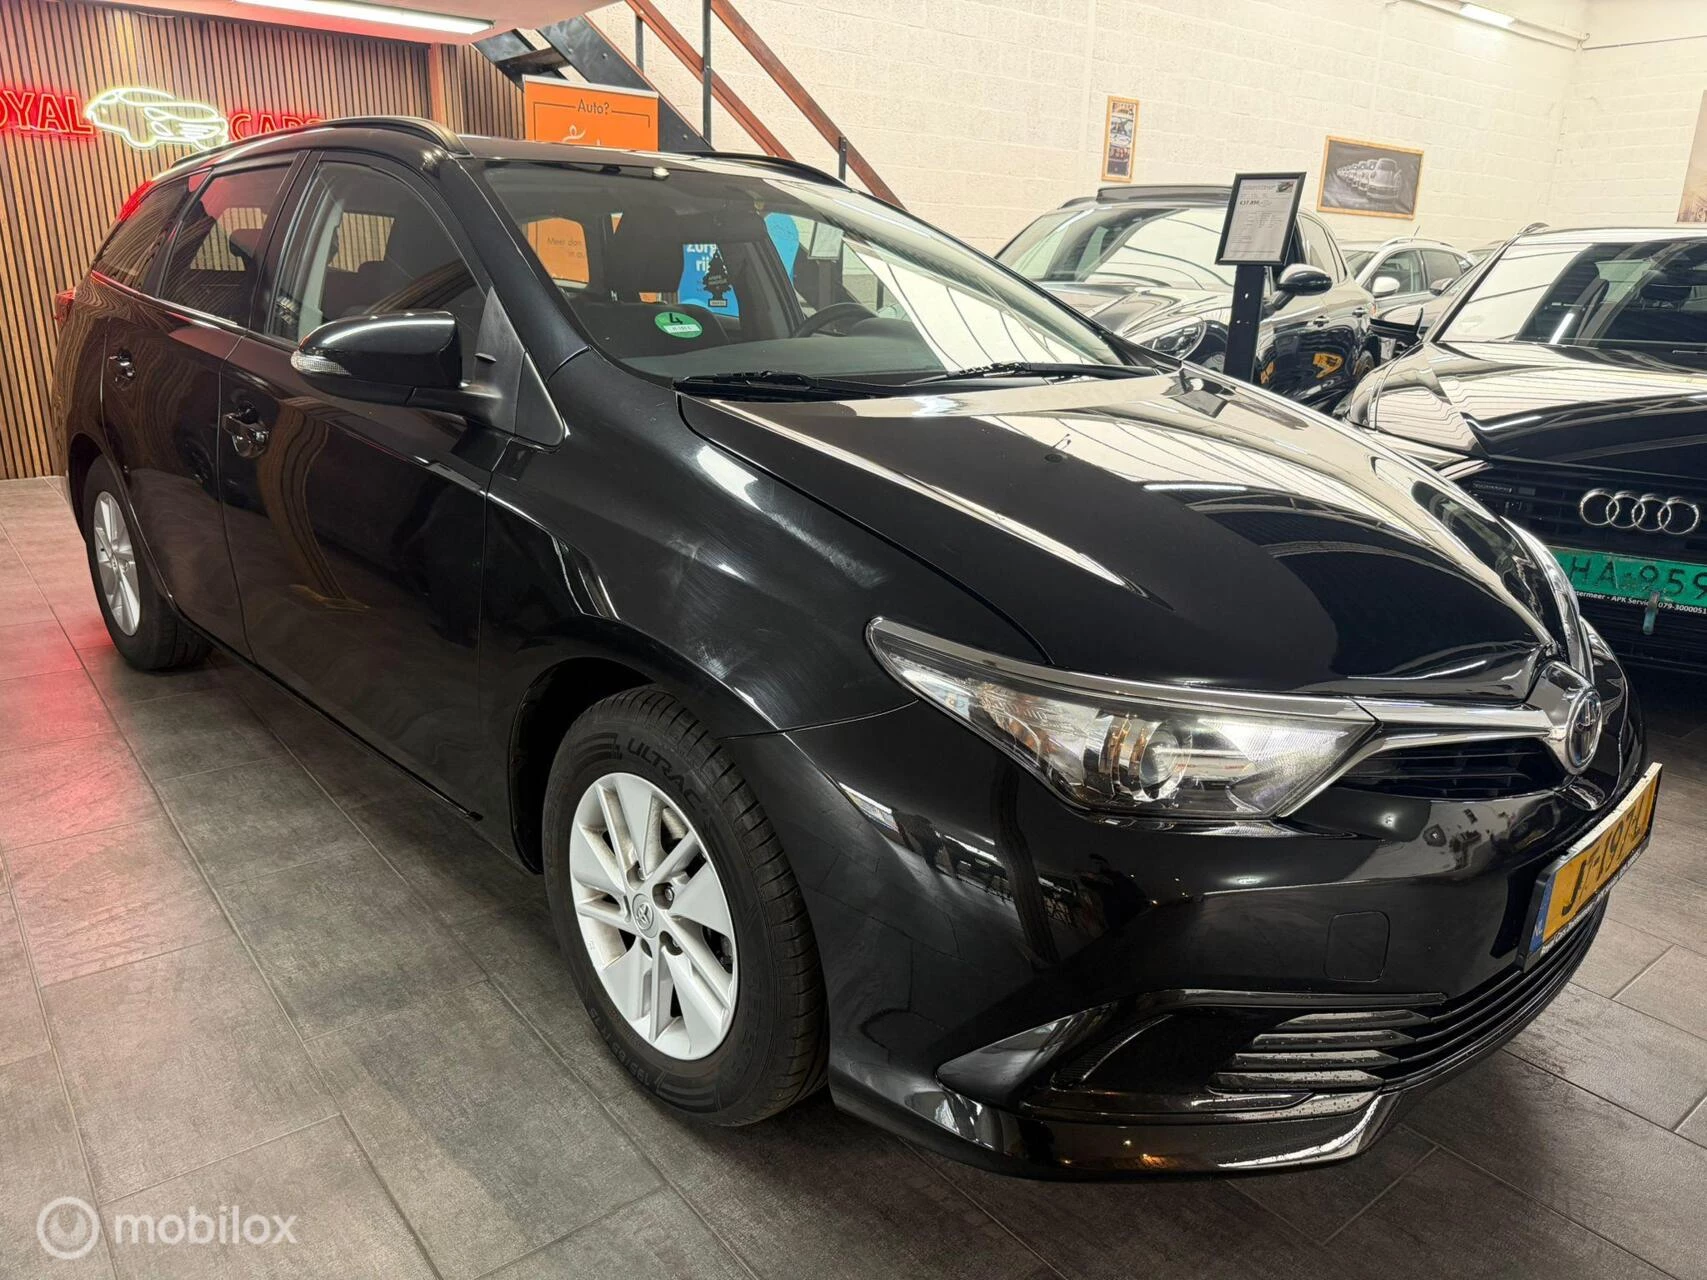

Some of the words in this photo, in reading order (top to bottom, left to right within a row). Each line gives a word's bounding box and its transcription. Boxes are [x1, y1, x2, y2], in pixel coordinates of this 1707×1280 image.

[577, 99, 610, 115] Auto?
[230, 113, 322, 141] CA
[669, 313, 683, 324] 4
[1576, 591, 1605, 602] termeer
[1612, 595, 1627, 604] APK
[1628, 597, 1650, 606] Servic
[627, 737, 703, 810] ULTRAC
